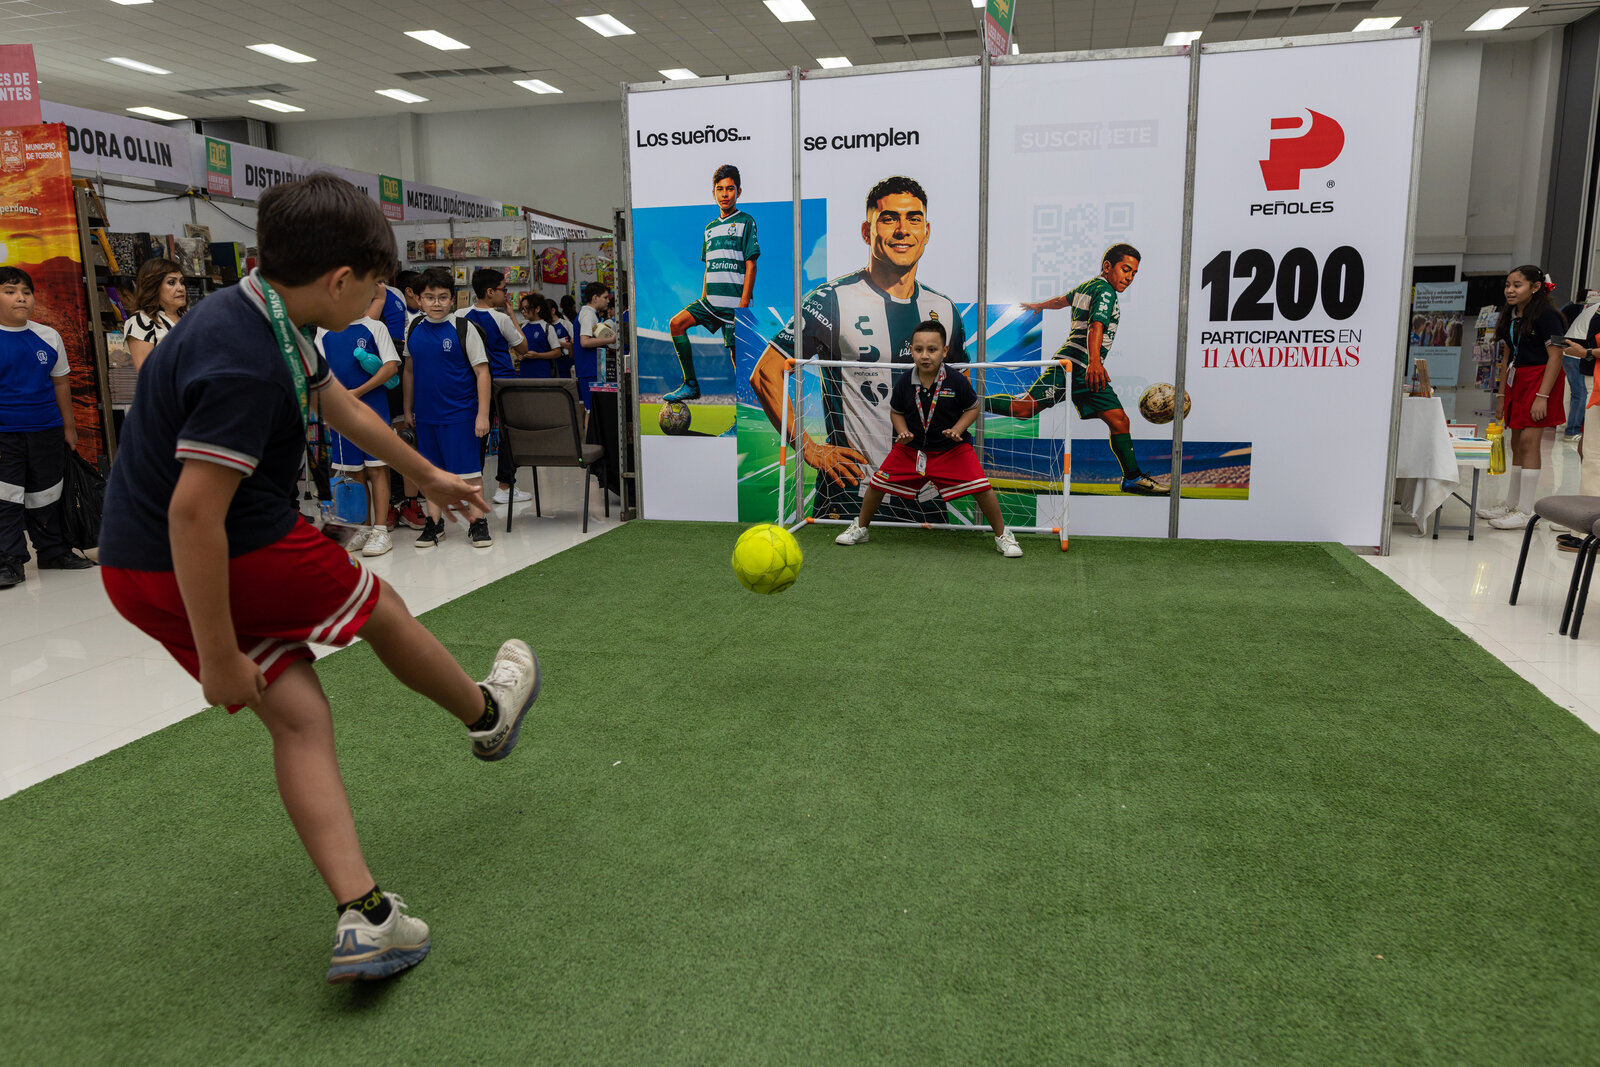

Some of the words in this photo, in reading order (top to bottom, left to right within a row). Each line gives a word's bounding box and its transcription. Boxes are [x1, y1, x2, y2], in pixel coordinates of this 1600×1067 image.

[14, 72, 30, 86] DE
[636, 130, 668, 148] Los
[671, 125, 751, 145] sueños...
[803, 133, 827, 151] se
[831, 127, 920, 152] cumplen
[25, 142, 56, 152] MUNICIPIO
[26, 152, 34, 160] DE
[35, 150, 62, 160] TORREÓN
[124, 136, 173, 168] OLLIN
[0, 203, 42, 216] perdonar.
[407, 190, 442, 213] MATERIAL
[443, 194, 476, 219] DIDÁCTICO
[476, 202, 484, 219] DE
[1250, 200, 1334, 216] PEÑOLES
[711, 261, 738, 271] Soriana
[1201, 245, 1365, 322] 1200
[1201, 329, 1335, 345] PARTICIPANTES
[1338, 329, 1362, 344] EN
[1201, 347, 1220, 369] 11
[1223, 345, 1361, 369] ACADEMIAS
